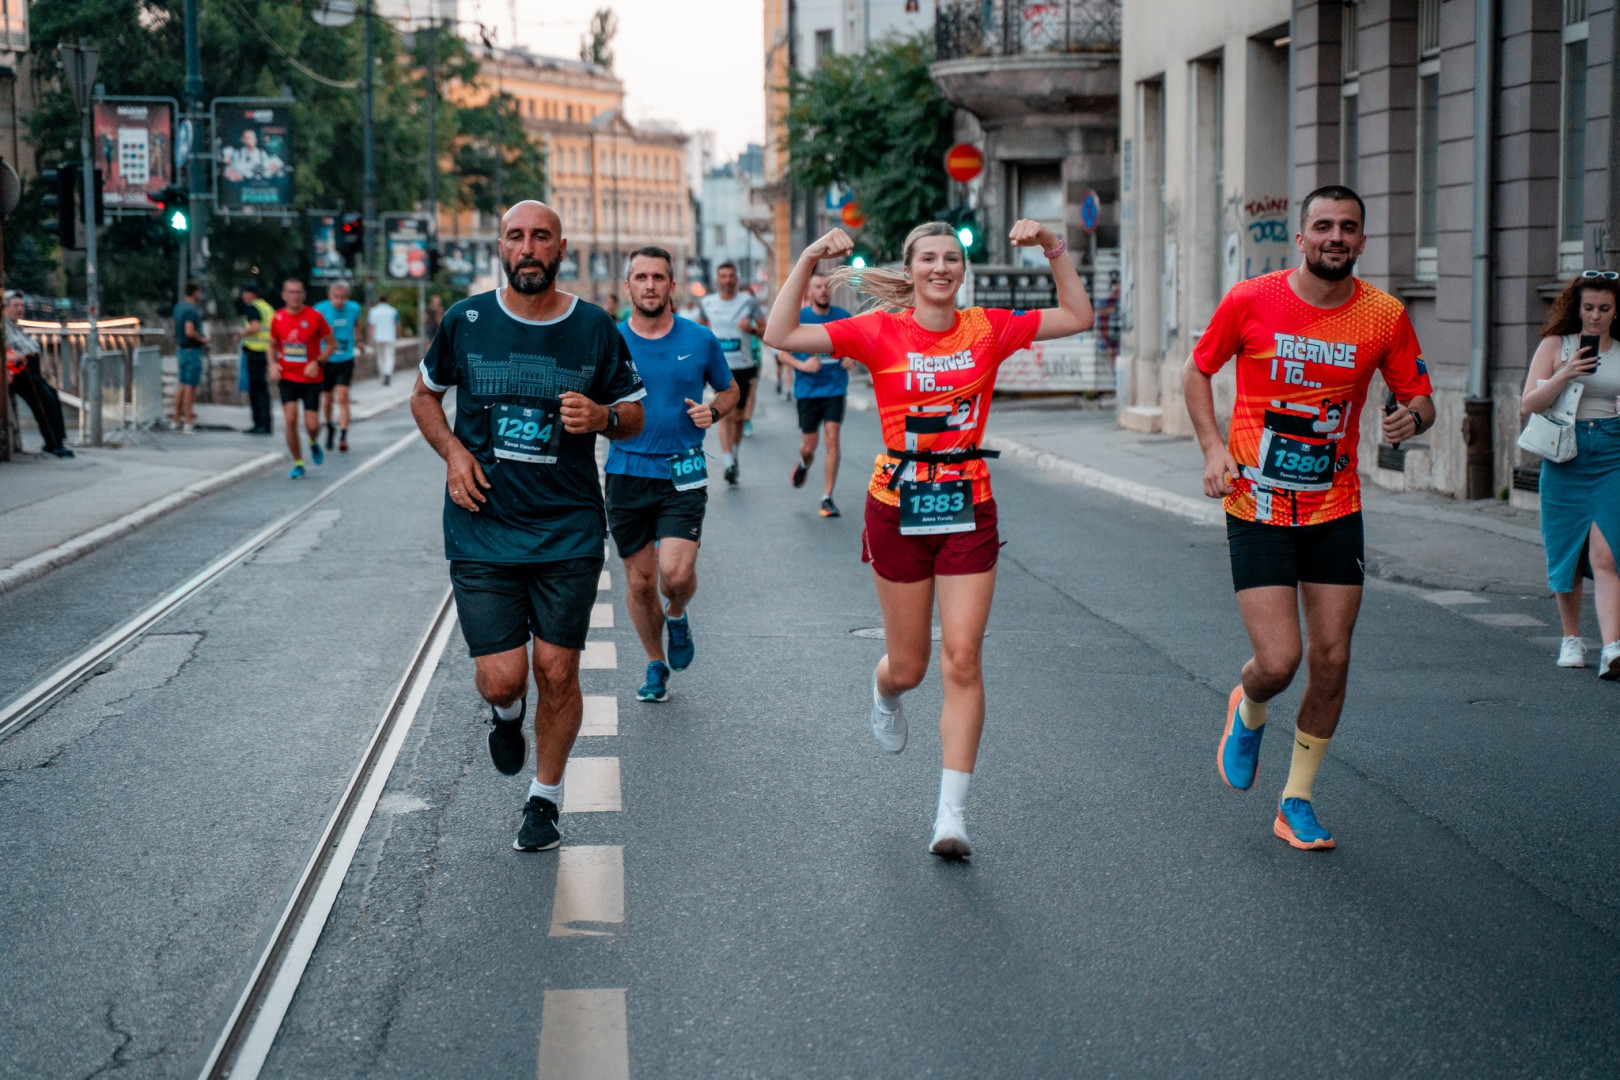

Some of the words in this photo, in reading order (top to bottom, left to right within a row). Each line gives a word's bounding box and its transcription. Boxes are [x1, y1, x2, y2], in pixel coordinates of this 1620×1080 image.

[1273, 332, 1358, 369] TRČANJE
[1270, 358, 1279, 381] I
[905, 372, 912, 391] I
[497, 417, 553, 443] 1294
[1274, 449, 1330, 473] 1380
[910, 492, 965, 514] 1383
